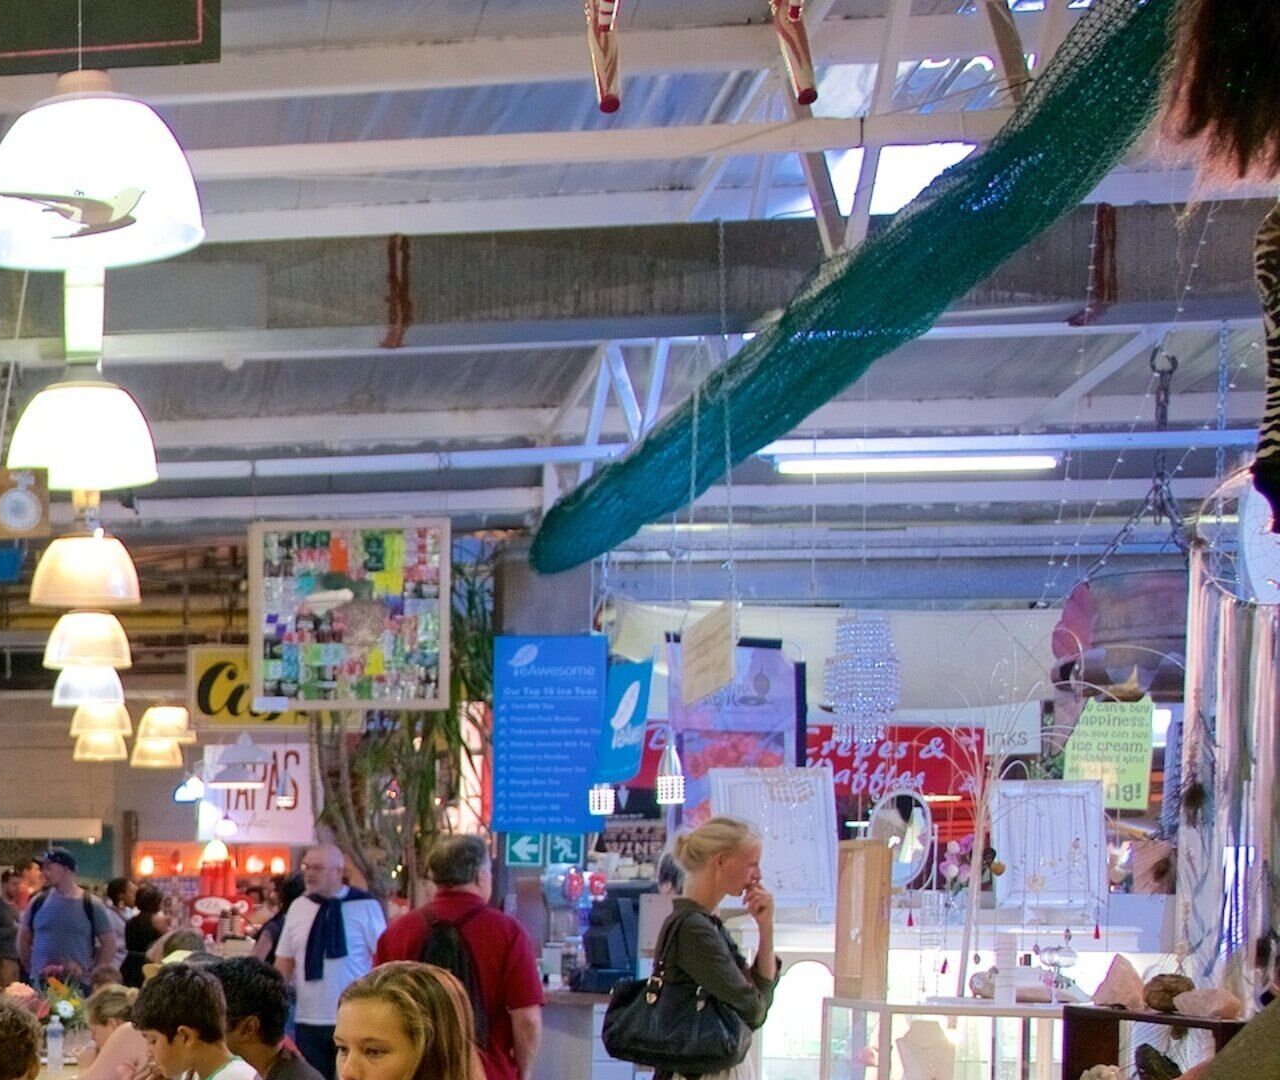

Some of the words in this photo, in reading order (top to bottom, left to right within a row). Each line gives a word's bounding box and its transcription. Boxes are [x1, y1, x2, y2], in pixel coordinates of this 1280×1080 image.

[1080, 715, 1149, 728] appiness.
[986, 729, 1027, 746] inks
[919, 737, 945, 760] &
[1096, 741, 1147, 753] cream.
[1106, 783, 1142, 802] ng!
